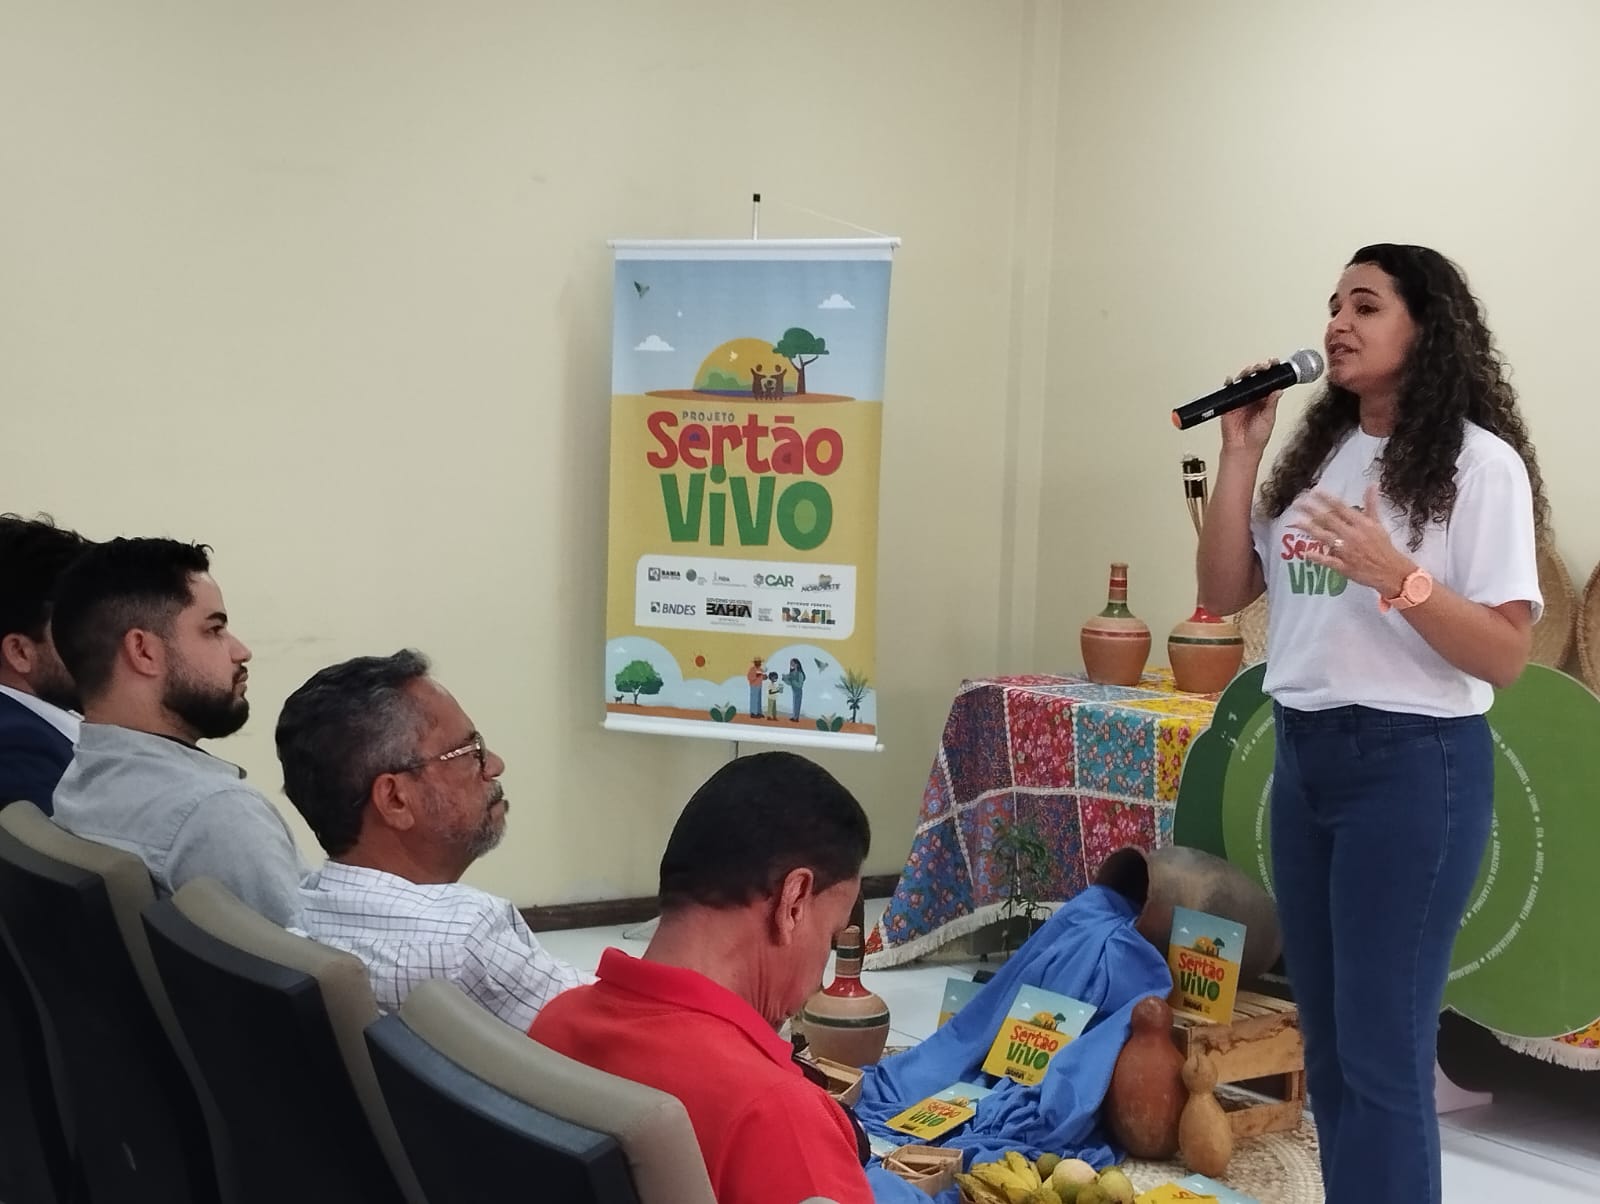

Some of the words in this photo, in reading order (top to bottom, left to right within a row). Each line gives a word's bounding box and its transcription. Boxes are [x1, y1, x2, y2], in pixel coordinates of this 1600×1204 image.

[682, 411, 735, 422] PROJETO
[646, 411, 844, 476] Sertão
[765, 574, 794, 587] CAR
[662, 603, 696, 616] BNDES
[706, 603, 752, 618] BAHIA
[782, 607, 836, 625] BRASIL
